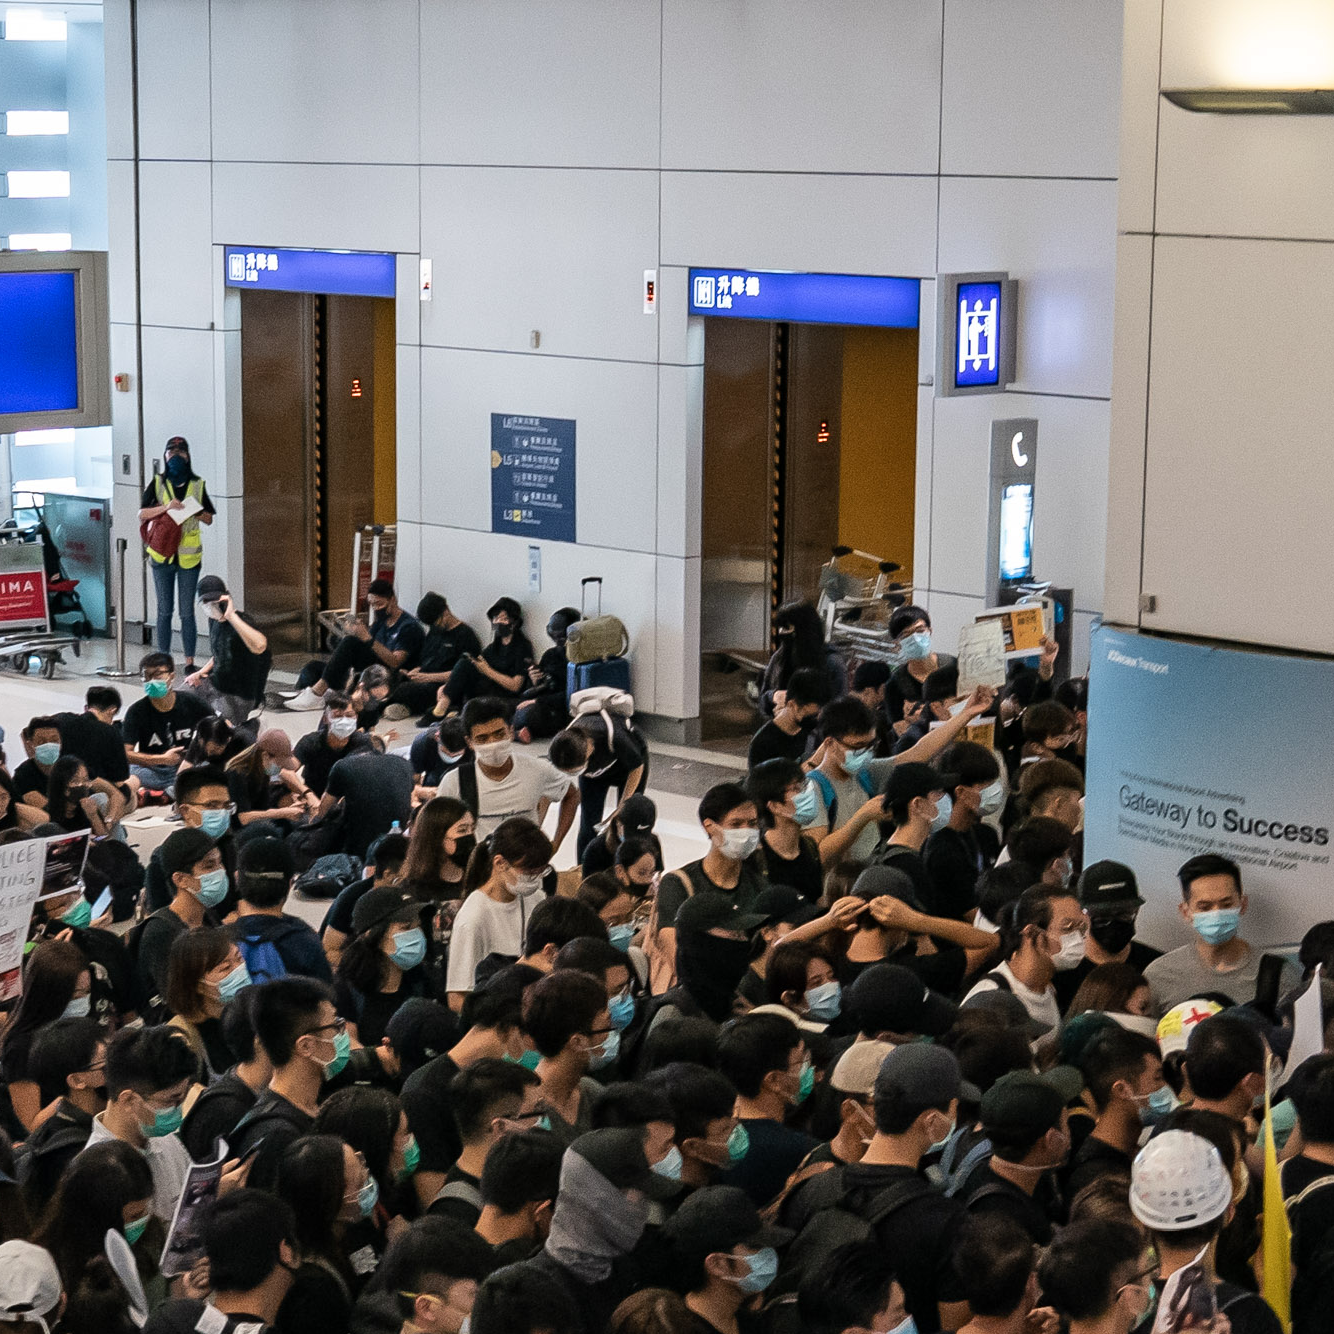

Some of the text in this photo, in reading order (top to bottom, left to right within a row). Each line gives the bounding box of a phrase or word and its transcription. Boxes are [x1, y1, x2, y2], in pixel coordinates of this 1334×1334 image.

[1119, 784, 1192, 829] Gateway
[1196, 804, 1217, 829] to
[1222, 808, 1329, 846] Success
